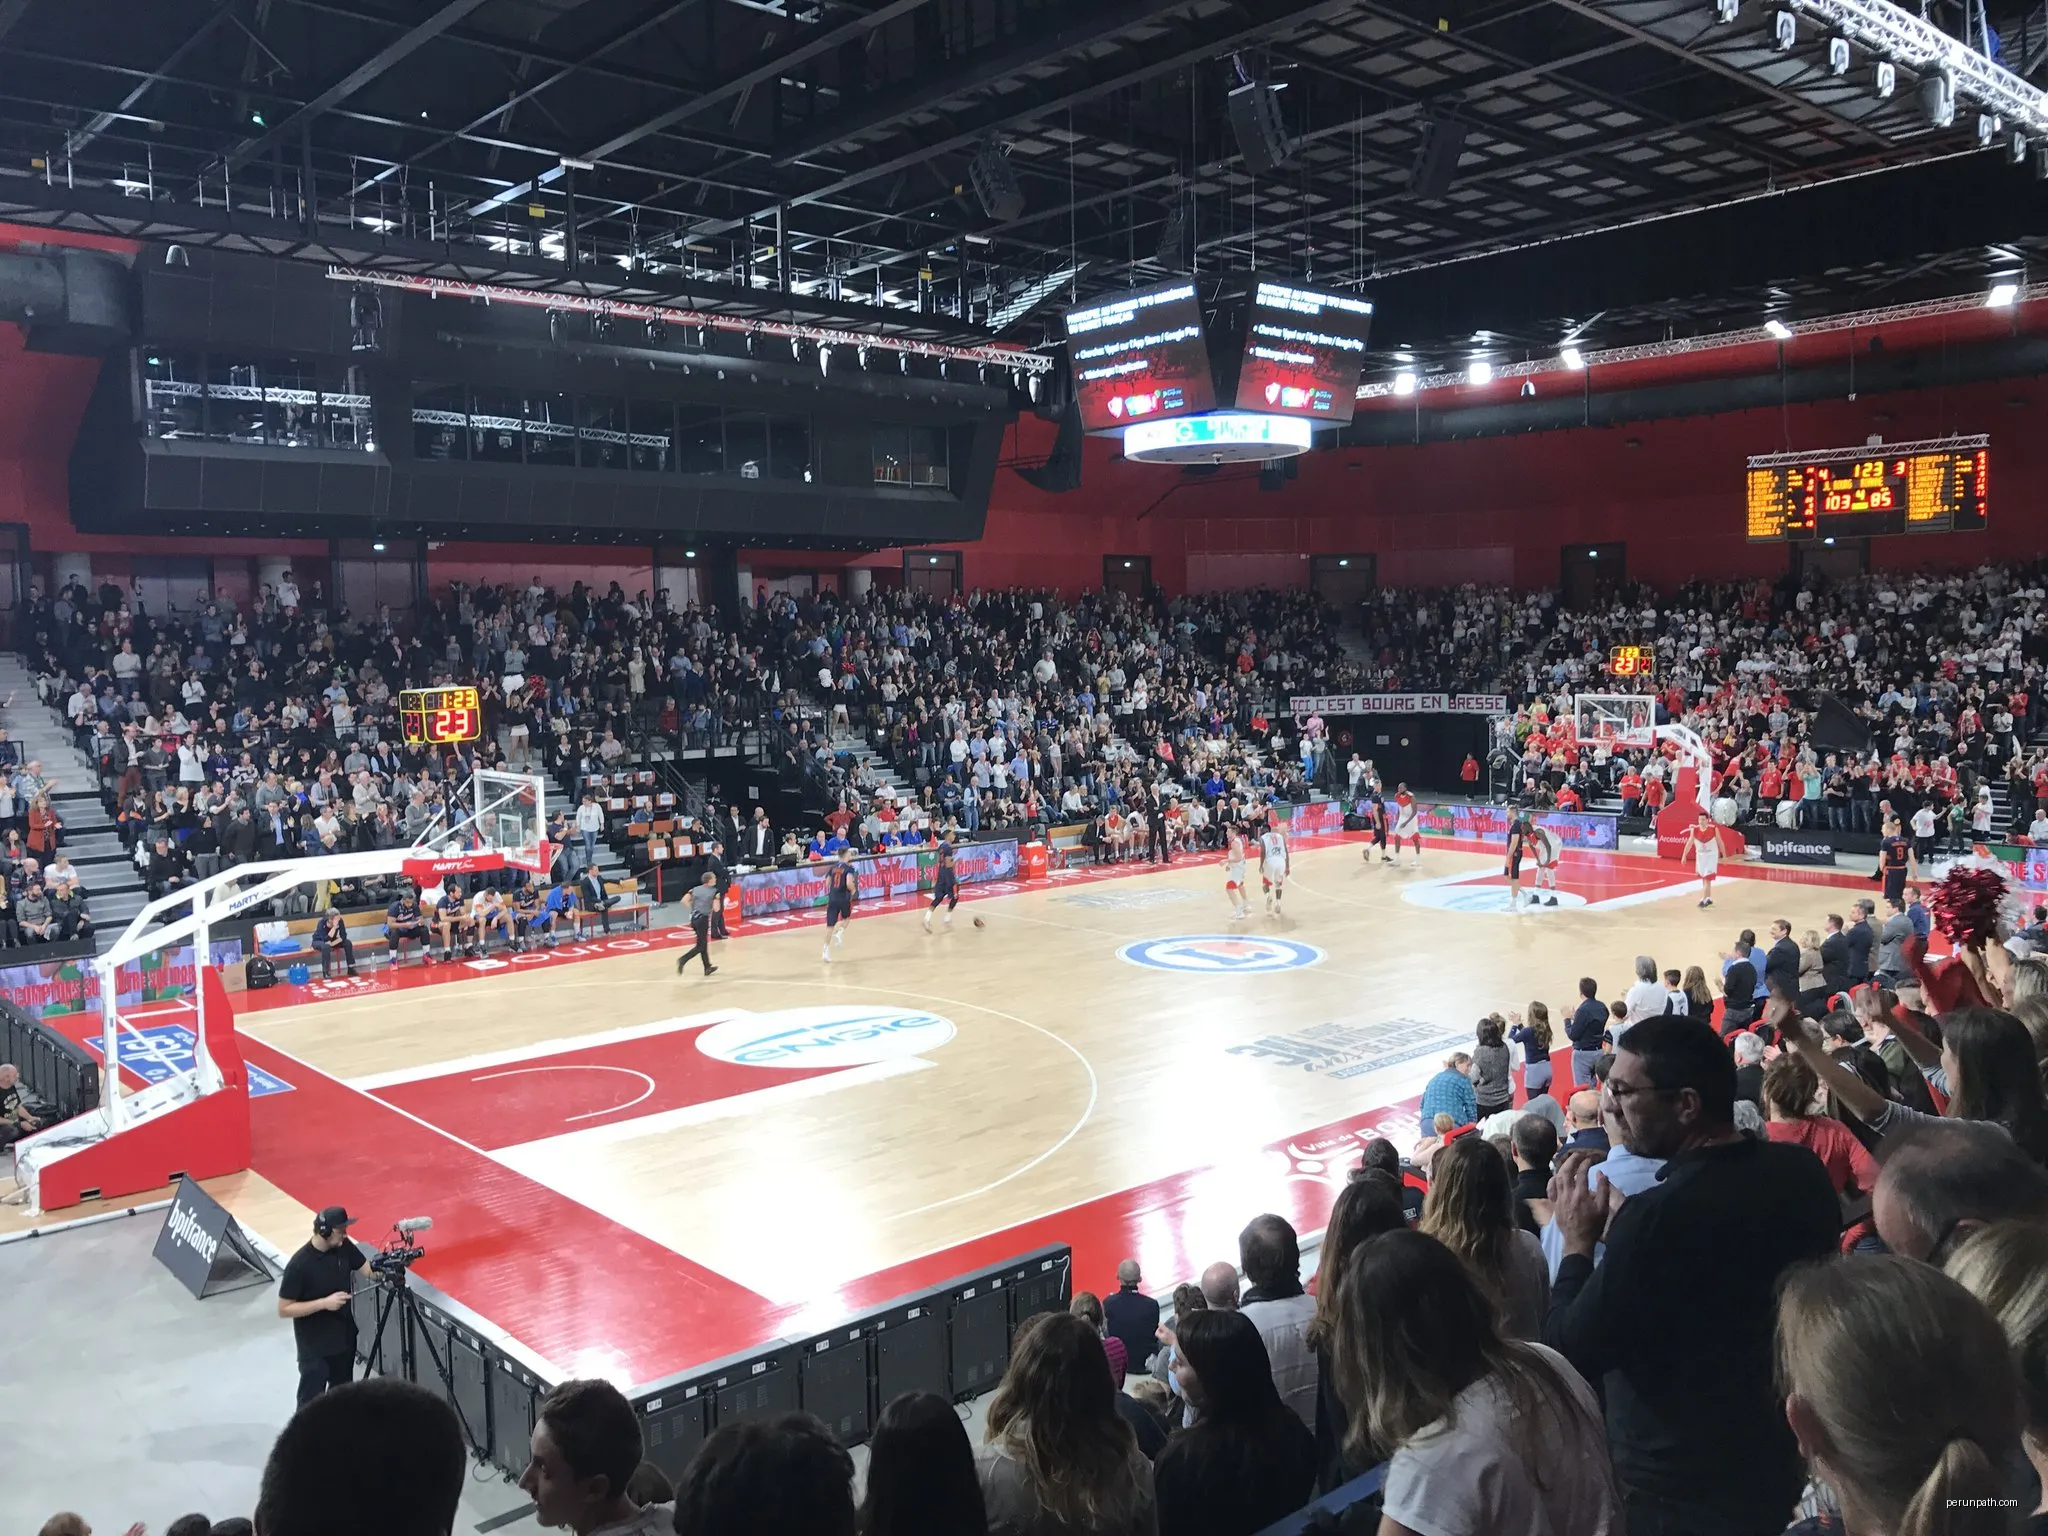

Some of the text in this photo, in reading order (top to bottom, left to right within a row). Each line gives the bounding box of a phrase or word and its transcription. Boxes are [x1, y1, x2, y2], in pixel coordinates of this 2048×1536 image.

[1825, 494, 1851, 510] 103
[1871, 491, 1891, 507] 85
[1615, 657, 1634, 672] 23
[1291, 699, 1310, 712] ICI
[1362, 697, 1414, 710] BOURG
[1421, 696, 1442, 709] EN
[1449, 697, 1504, 710] BRESSE
[436, 709, 468, 736] 23
[1659, 834, 1690, 845] ArcelorM
[1767, 839, 1831, 857] bpifrance
[432, 862, 462, 871] MARTY
[745, 885, 781, 906] NOUS
[784, 880, 830, 902] COMPT
[229, 892, 259, 911] MARTY
[14, 979, 80, 1008] COMPTONS
[84, 976, 100, 998] SU
[1301, 1139, 1336, 1152] Ville
[168, 1198, 217, 1264] bpifrance
